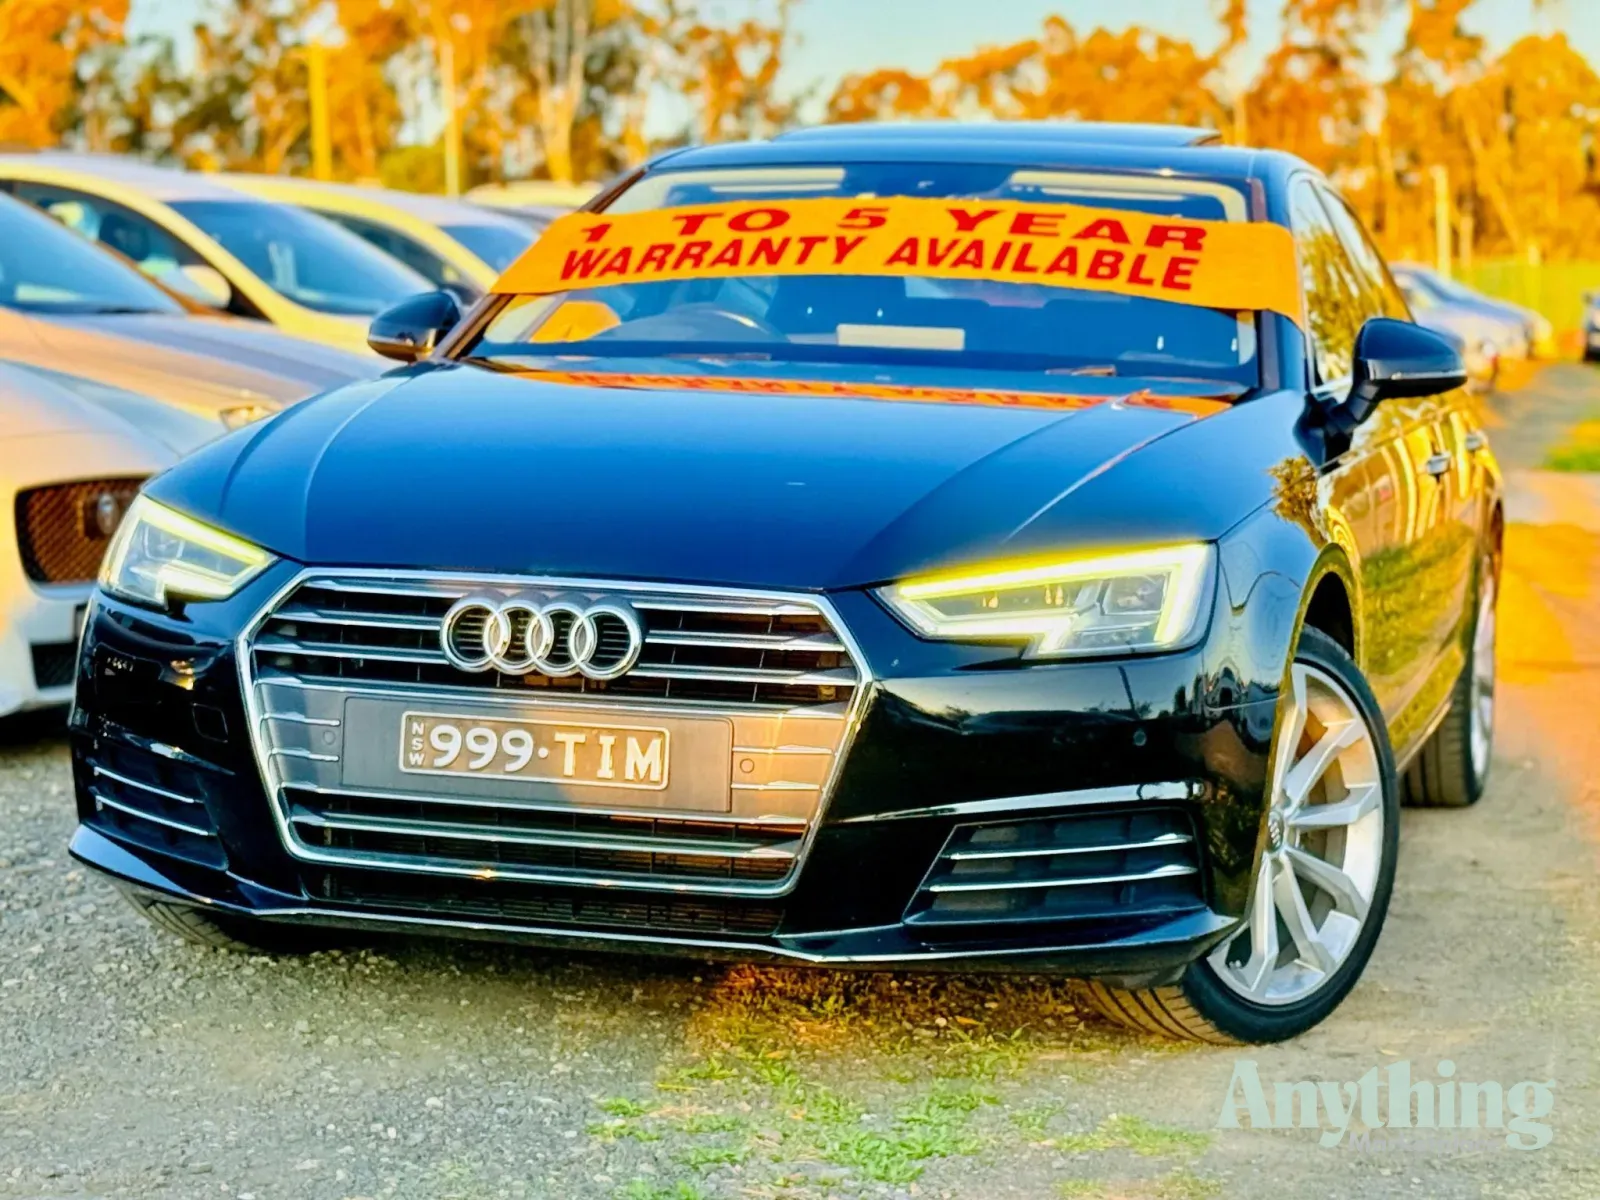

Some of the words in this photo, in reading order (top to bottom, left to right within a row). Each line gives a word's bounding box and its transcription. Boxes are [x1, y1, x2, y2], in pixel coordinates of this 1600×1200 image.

[582, 223, 612, 243] 1
[673, 208, 790, 236] TO
[837, 207, 890, 230] 5
[946, 208, 1207, 250] YEAR
[560, 236, 867, 280] WARRANTY
[884, 236, 1200, 291] AVAILABLE
